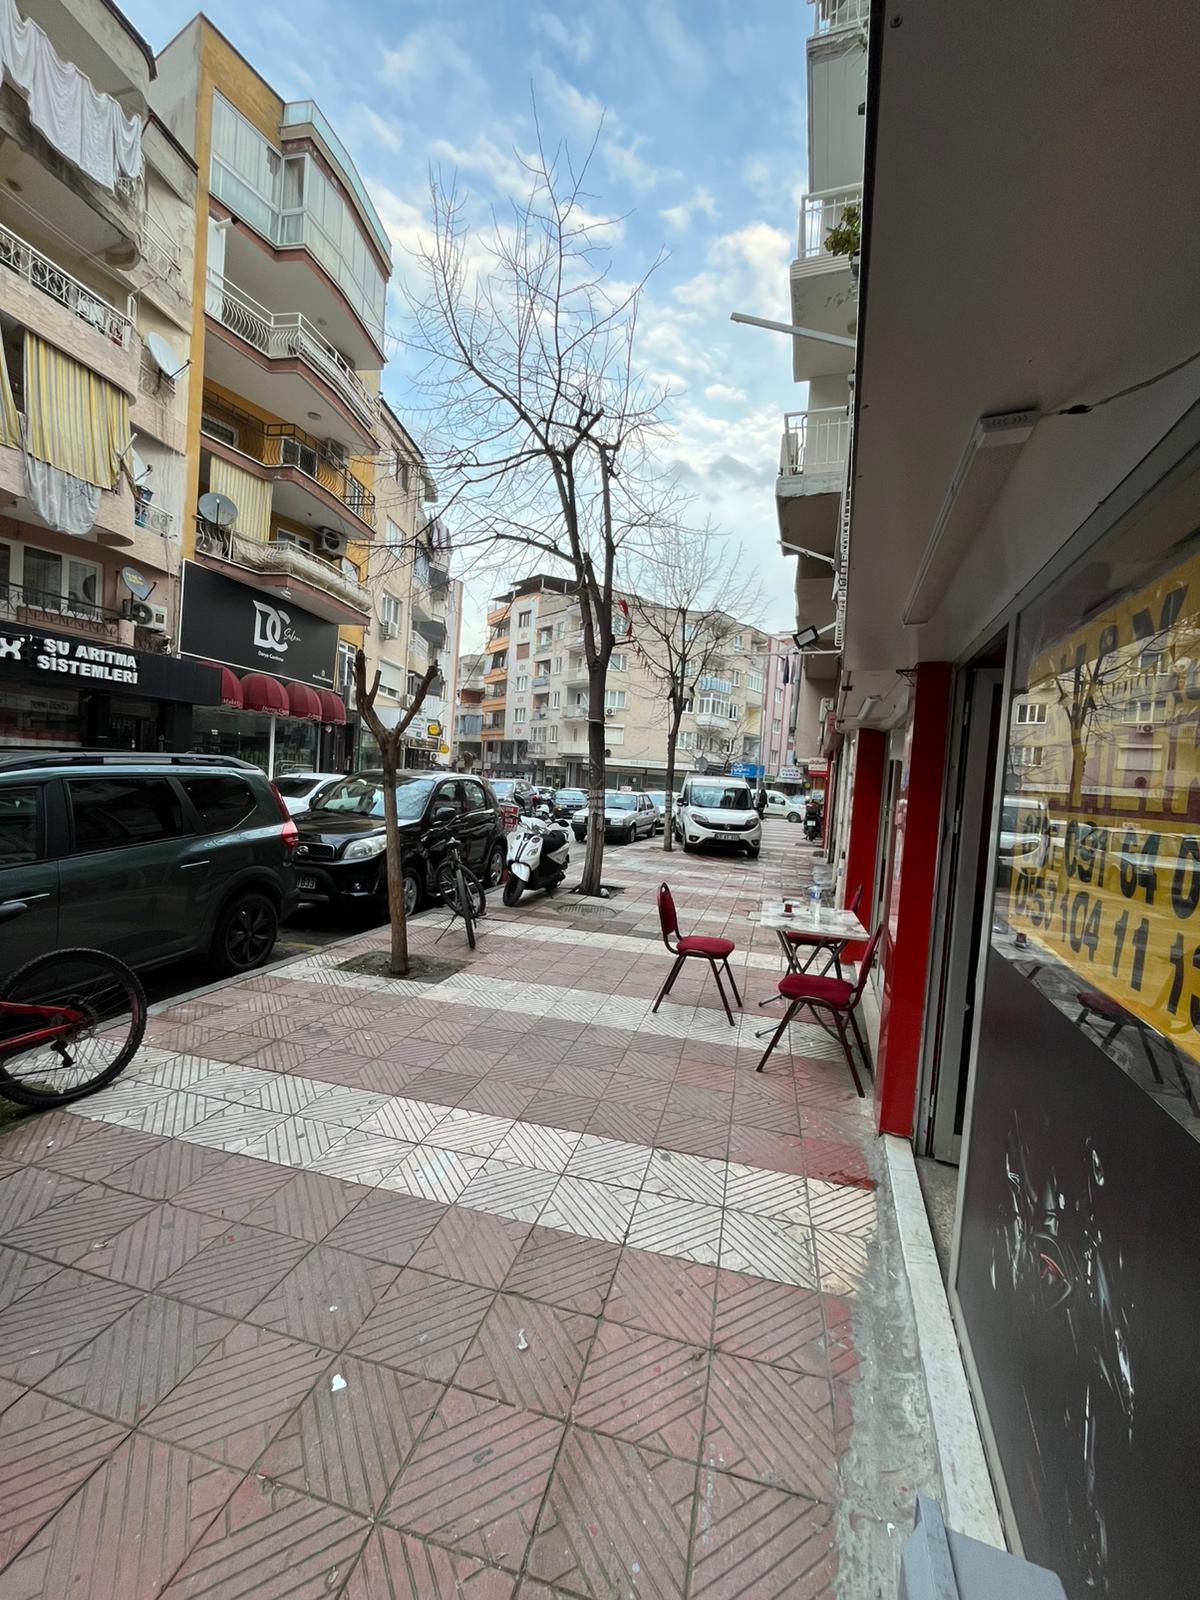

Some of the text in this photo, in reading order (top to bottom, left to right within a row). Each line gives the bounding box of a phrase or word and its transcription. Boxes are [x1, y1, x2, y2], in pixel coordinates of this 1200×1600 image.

[37, 653, 139, 684] SİSTEMLERİ
[43, 638, 137, 668] SU ARITMA
[1112, 909, 1149, 992] 11
